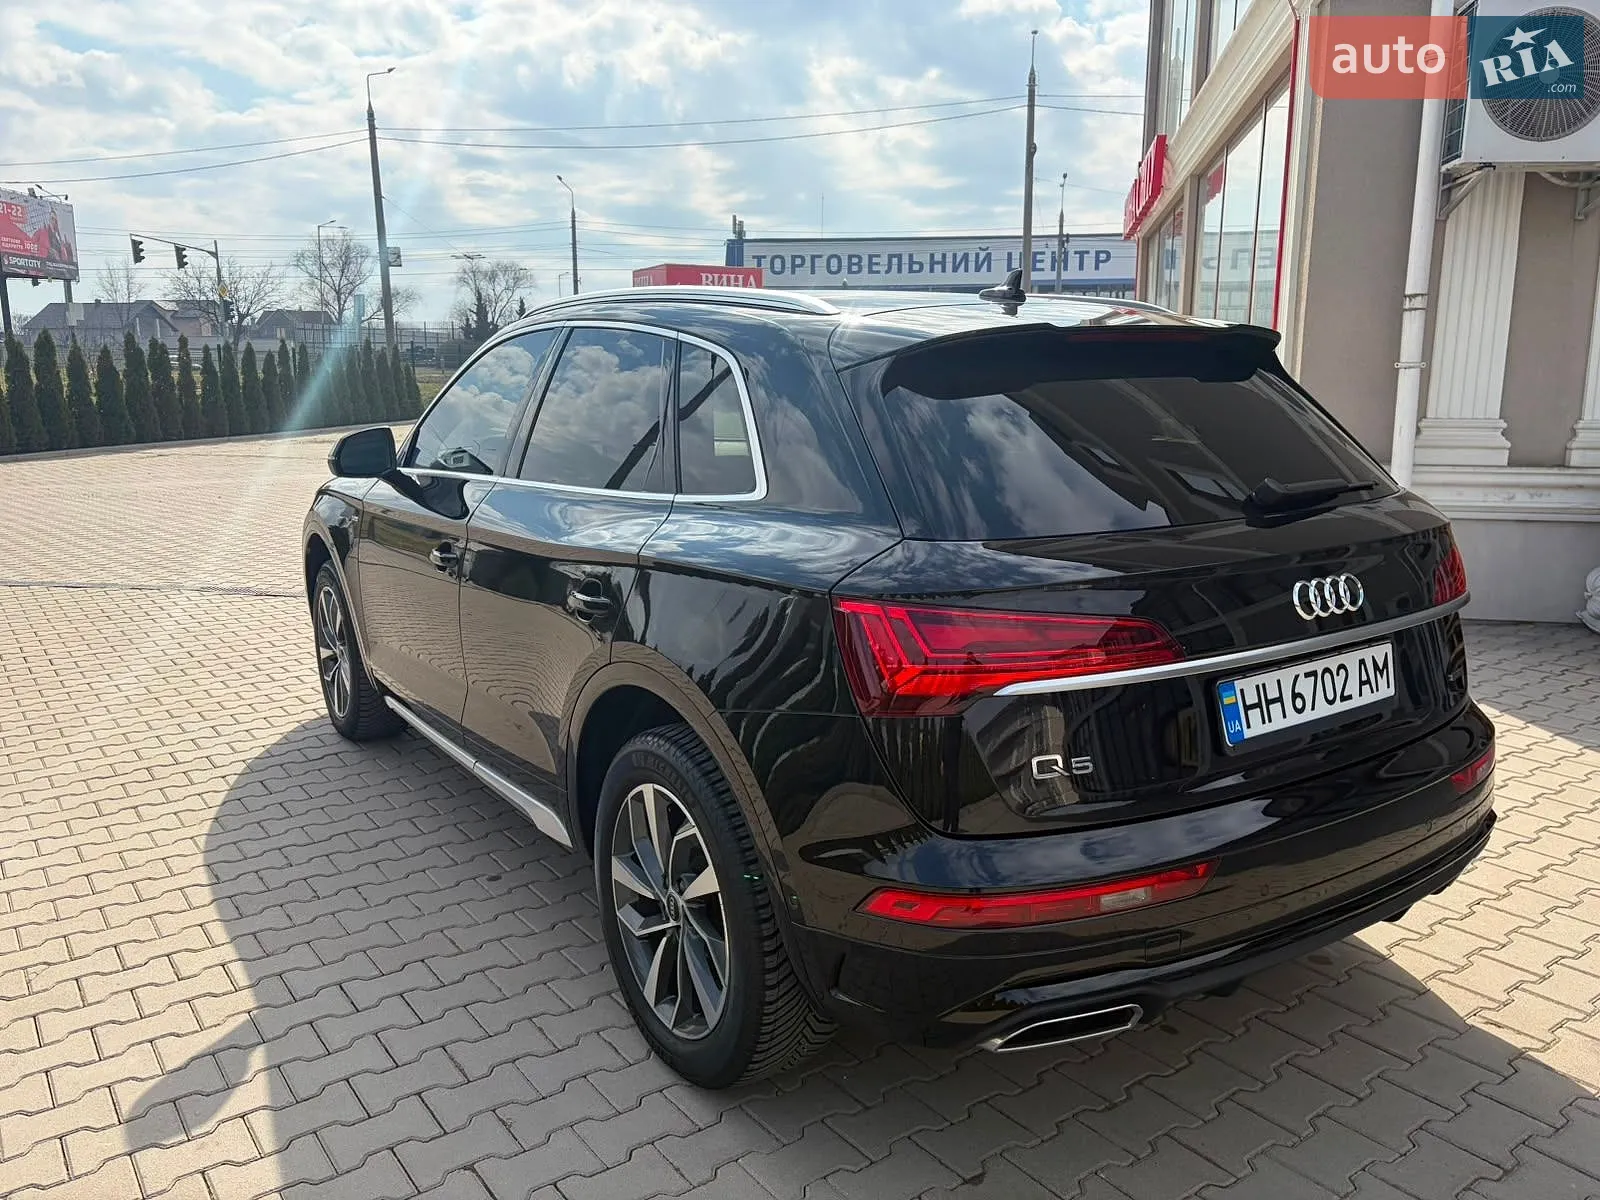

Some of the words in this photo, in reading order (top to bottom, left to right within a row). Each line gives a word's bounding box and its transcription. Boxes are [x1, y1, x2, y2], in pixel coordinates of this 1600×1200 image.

[752, 246, 992, 275] ТОРГОВЕЛЬНИЙ
[1006, 249, 1112, 273] ЦЕНТР
[700, 272, 756, 289] ВИНА
[1291, 663, 1353, 714] 6702
[1228, 723, 1242, 734] UA
[1031, 754, 1094, 779] Q5
